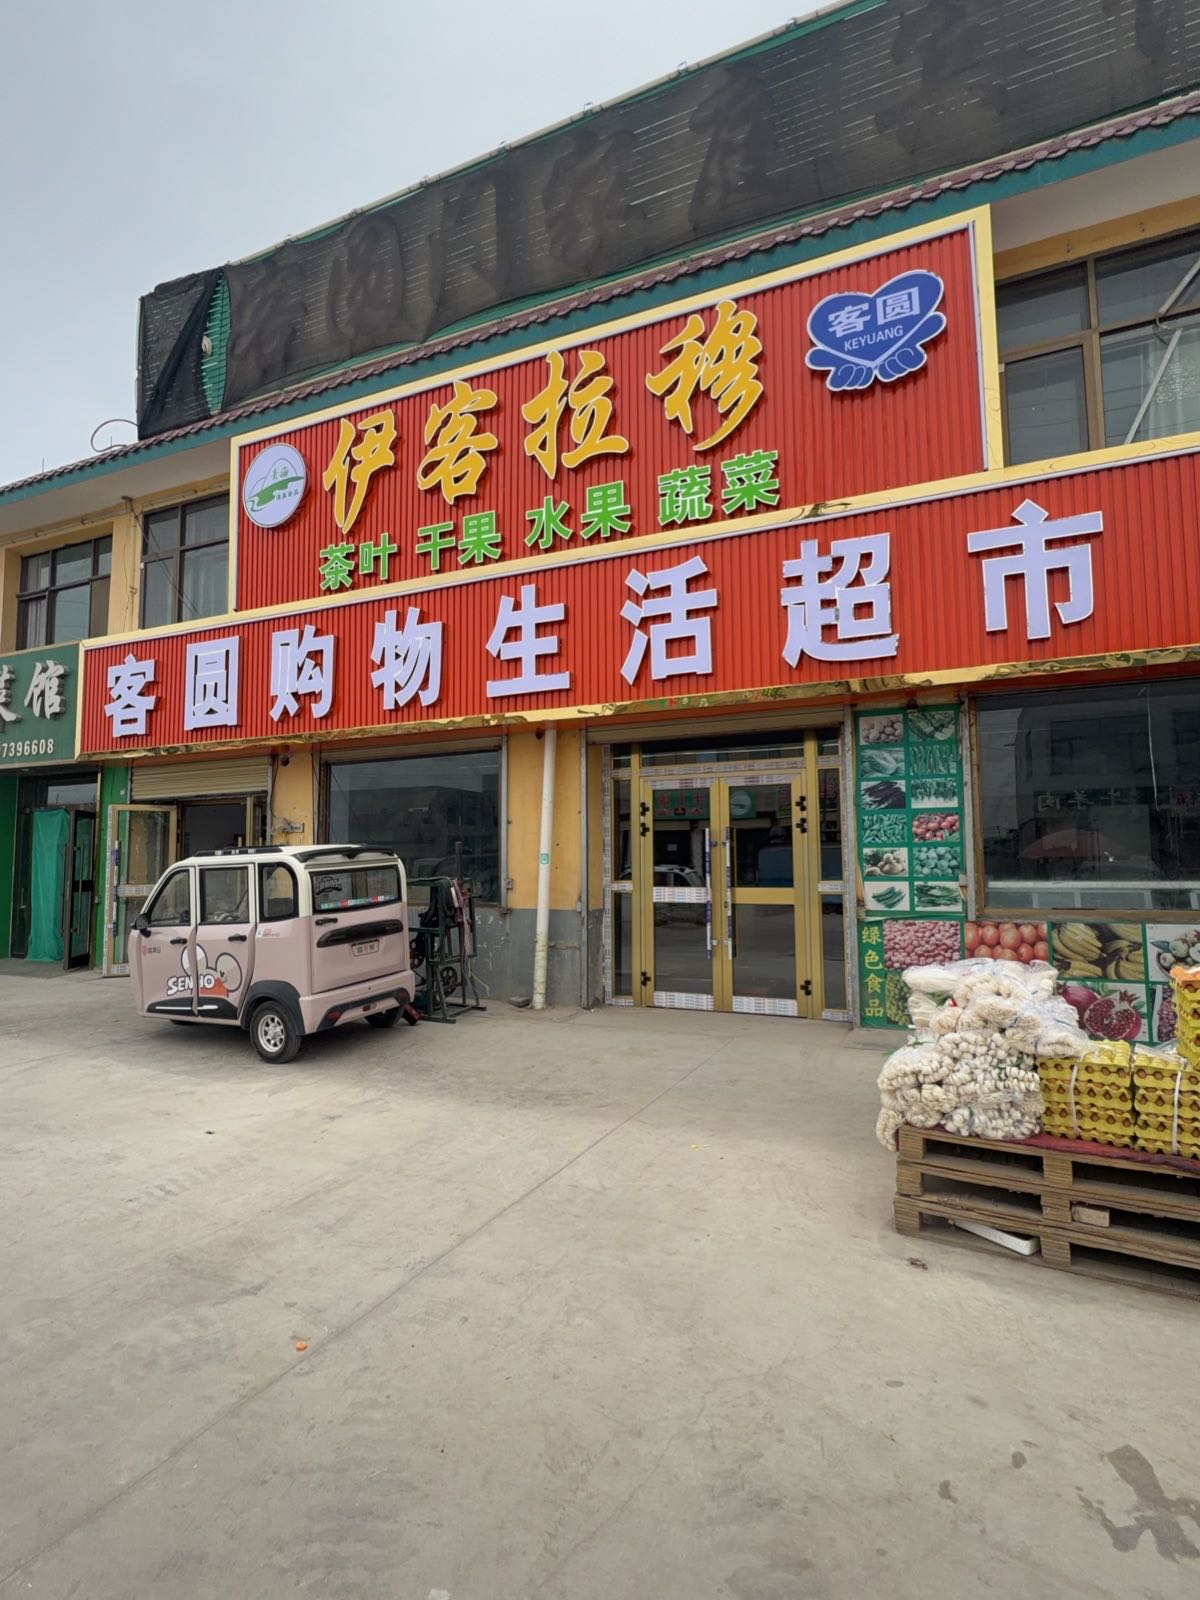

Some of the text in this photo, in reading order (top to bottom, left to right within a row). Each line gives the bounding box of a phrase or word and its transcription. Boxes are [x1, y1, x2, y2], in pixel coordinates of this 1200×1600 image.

[827, 286, 921, 338] 客圆
[843, 325, 904, 352] KEYUANG
[322, 299, 765, 535] 伊客拉穆
[318, 448, 782, 592] 茶叶 干果 水果 蔬菜
[103, 498, 1104, 738] 客圆购物生活超市
[861, 926, 886, 1018] 绿色食品
